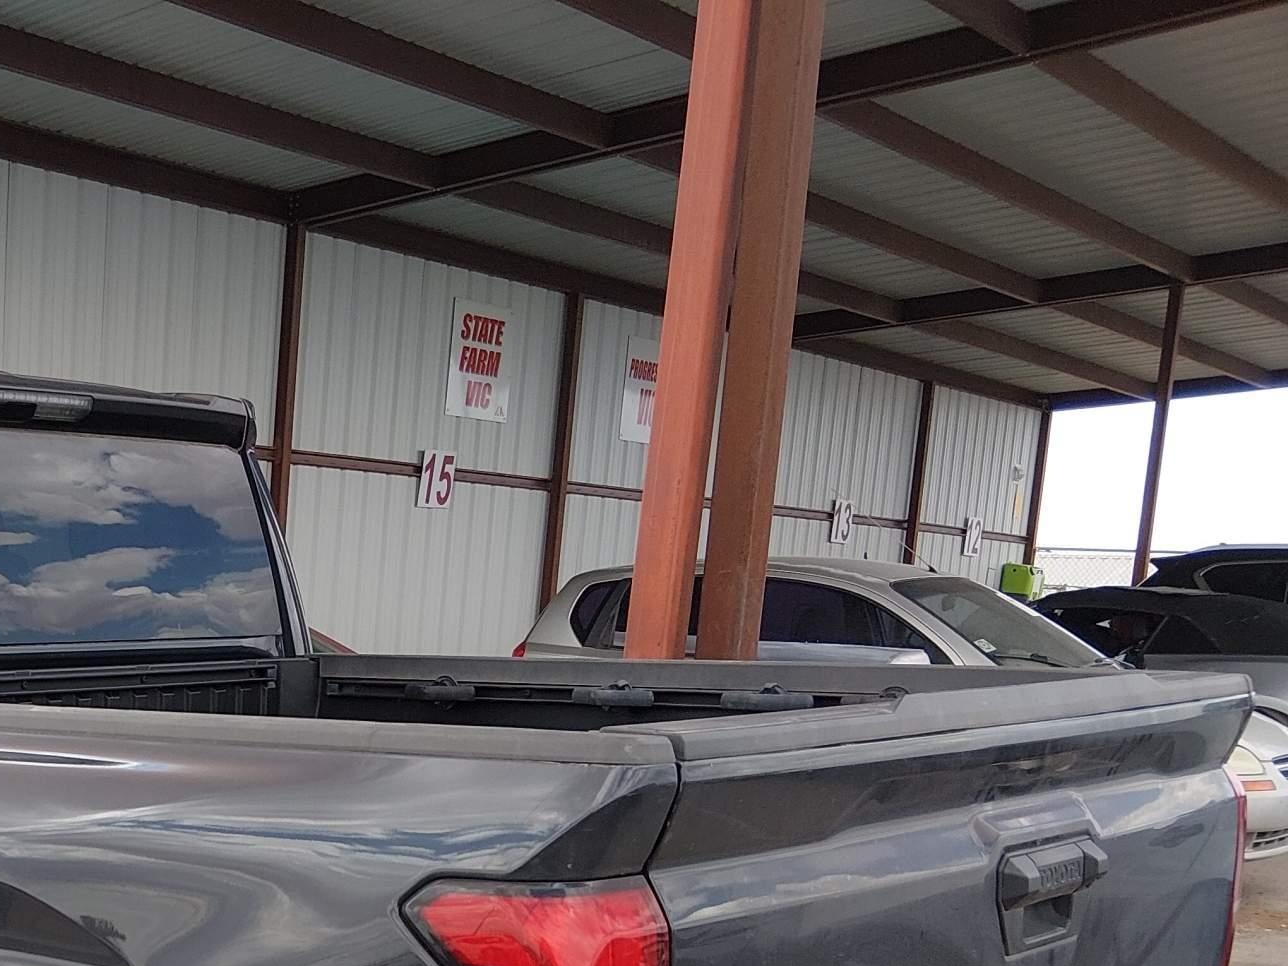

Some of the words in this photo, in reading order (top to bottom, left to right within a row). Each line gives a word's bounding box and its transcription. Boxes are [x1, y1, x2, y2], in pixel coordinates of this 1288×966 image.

[460, 312, 506, 346] STATE
[458, 346, 502, 378] FARM
[465, 380, 493, 410] VIC
[423, 452, 455, 506] 15
[833, 502, 852, 542] 13
[966, 518, 983, 555] 12
